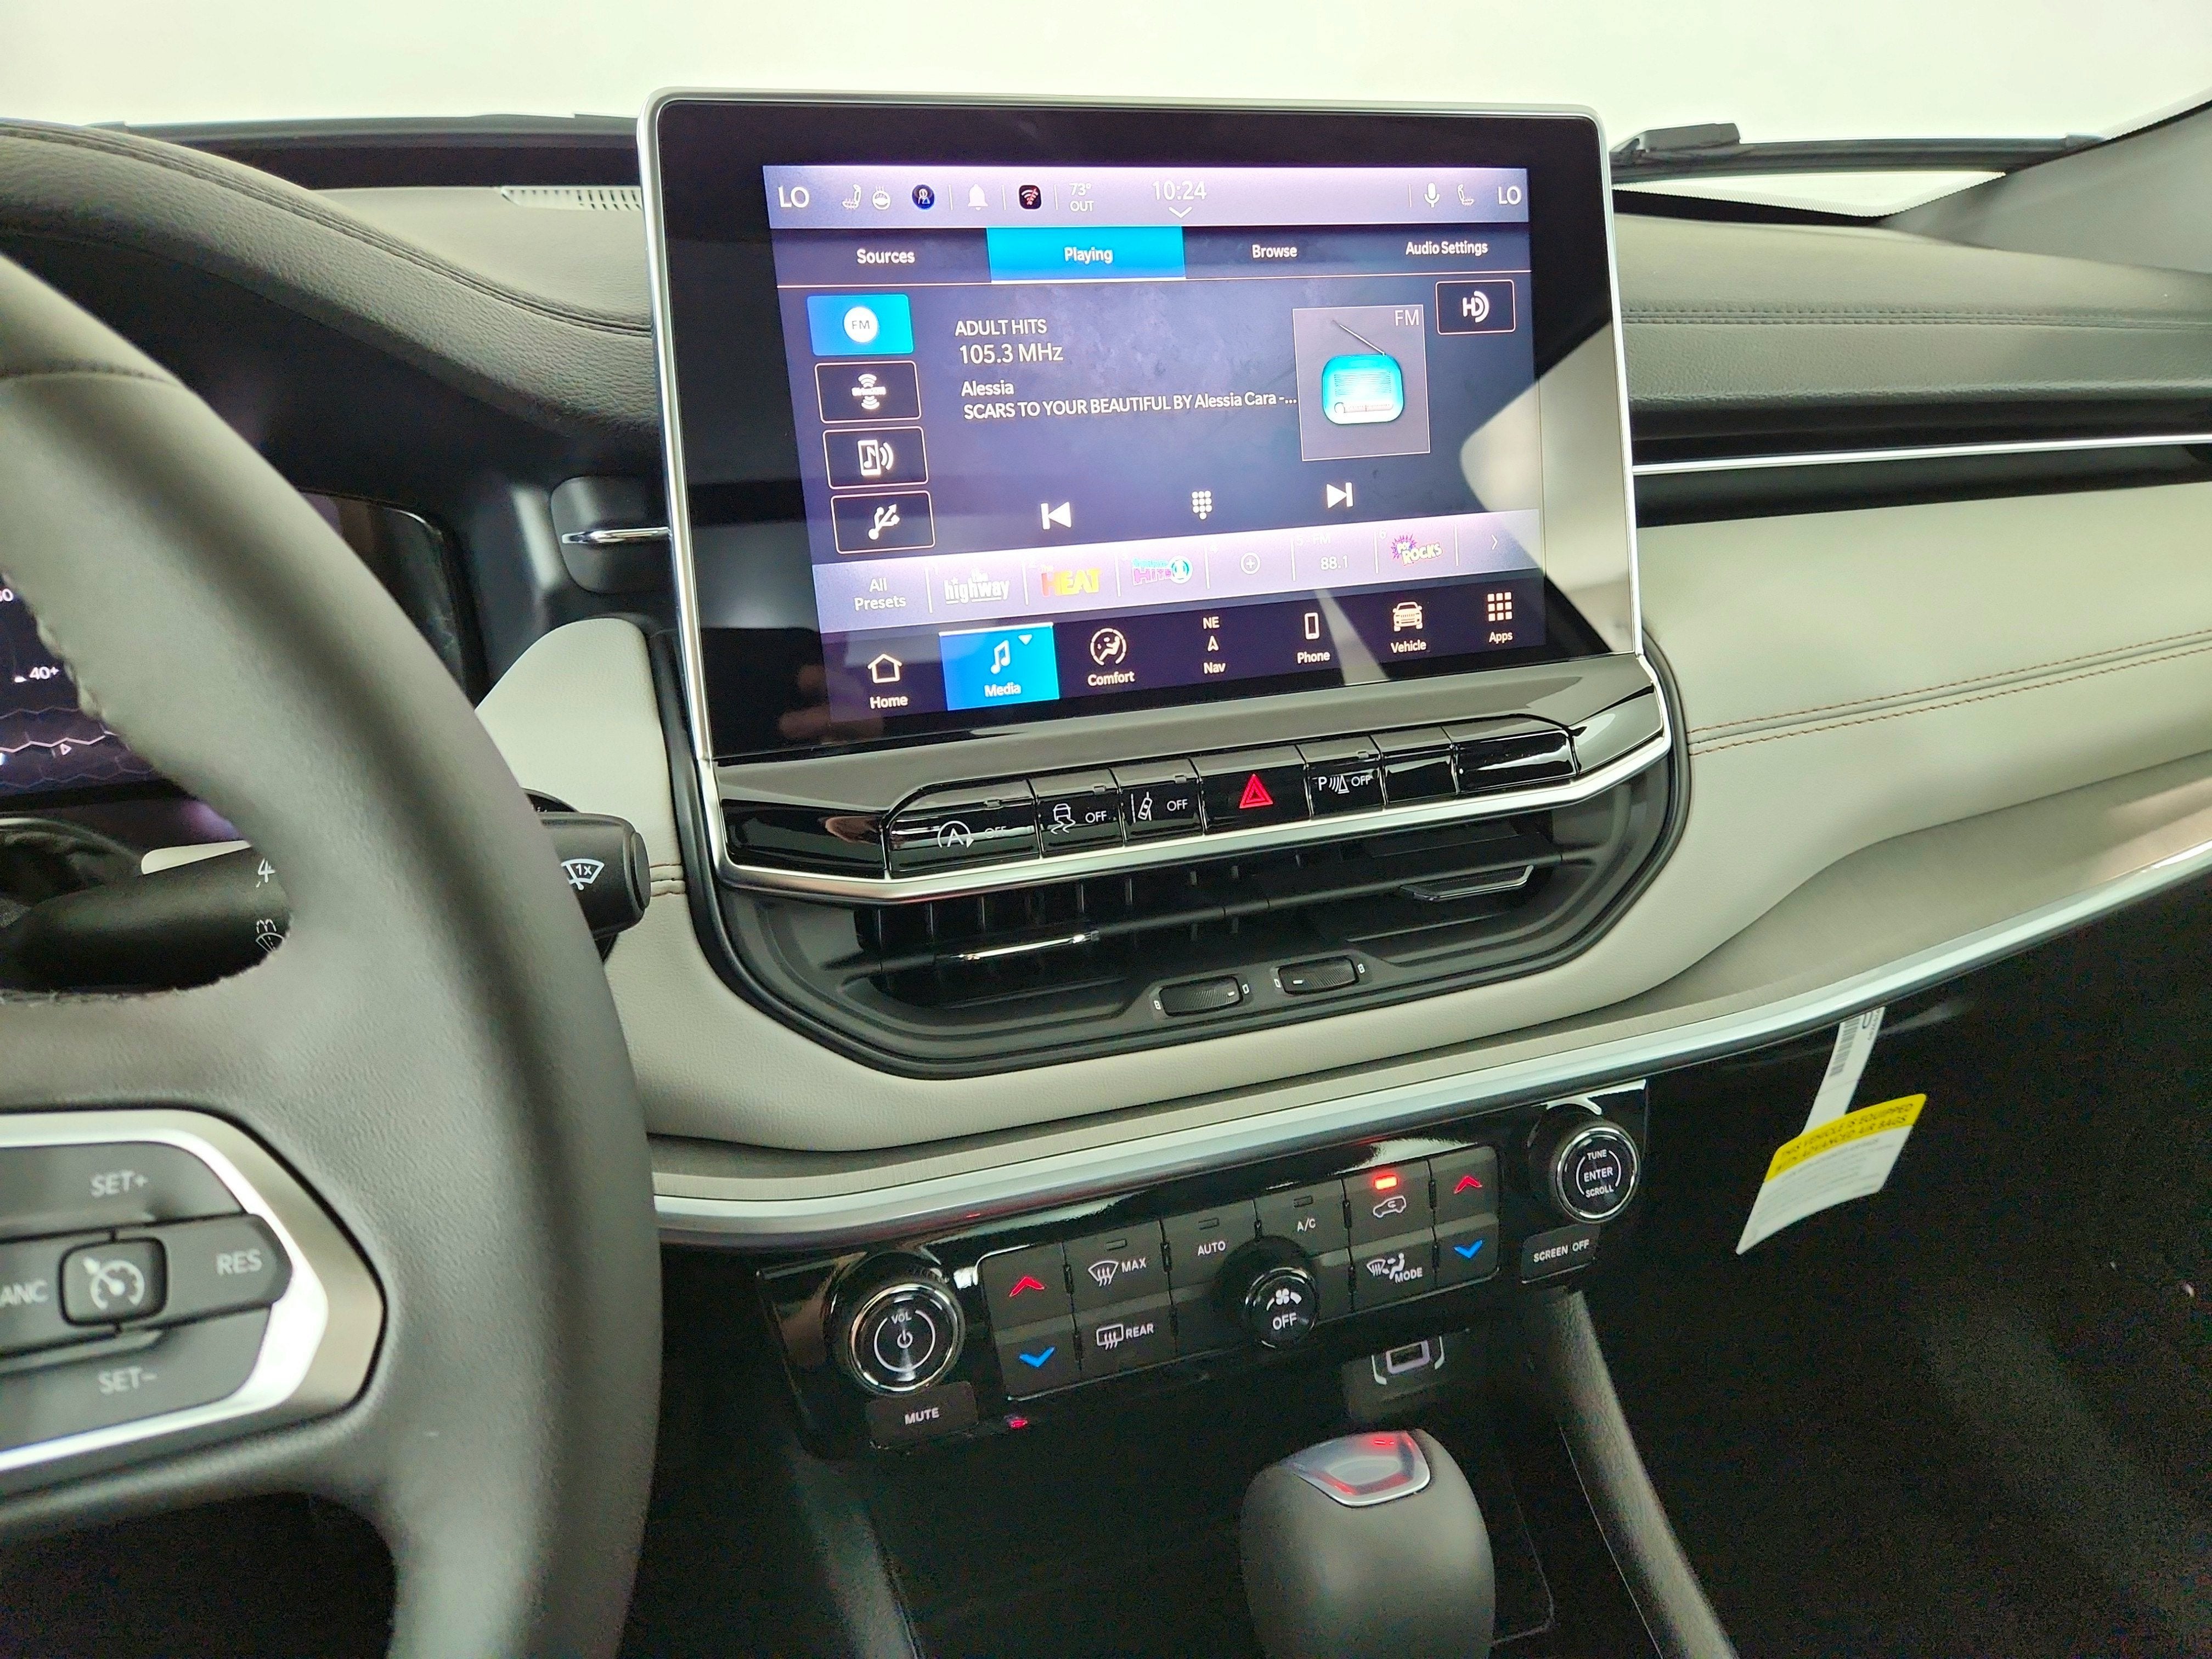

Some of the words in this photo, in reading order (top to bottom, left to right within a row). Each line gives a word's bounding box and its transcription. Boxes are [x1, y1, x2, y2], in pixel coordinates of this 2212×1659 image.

[778, 185, 809, 208] LO
[1152, 180, 1207, 201] 10:24
[1498, 186, 1522, 205] LO
[1069, 200, 1094, 212] OUT
[1064, 246, 1113, 264] Playing
[1252, 244, 1297, 259] Browse
[1406, 241, 1440, 256] Audio
[1441, 239, 1488, 256] Settings
[856, 249, 915, 264] Sources
[851, 319, 870, 330] FM
[1395, 309, 1419, 326] FM
[955, 319, 1008, 337] ADULT
[1012, 318, 1047, 335] HITS
[959, 343, 1014, 364] 105.3
[1018, 342, 1063, 362] MHz
[961, 380, 1014, 396] Alessia
[963, 402, 1015, 420] SCARS
[1017, 401, 1040, 417] TO
[1042, 399, 1088, 416] YOUR
[1090, 396, 1171, 414] BEAUTIFUL
[1173, 394, 1193, 410] BY
[1194, 392, 1243, 409] Alessia
[1244, 390, 1277, 407] Cara
[1402, 543, 1443, 565] ROCKS
[1321, 555, 1348, 570] 88.1
[869, 578, 887, 592] All
[944, 577, 1009, 603] highway
[1042, 567, 1101, 597] HEAT
[855, 594, 906, 611] Presets
[1203, 617, 1220, 629] NE
[1489, 630, 1513, 644] Apps
[1391, 639, 1426, 653] Vehicle
[1297, 650, 1330, 664] Phone
[29, 665, 59, 680] 40+
[1204, 662, 1226, 674] Nav
[1087, 671, 1135, 686] Comfort
[984, 682, 1022, 697] Media
[870, 695, 908, 709] Home
[1318, 776, 1327, 791] P
[1351, 775, 1373, 786] OFF
[1167, 799, 1188, 812] OFF
[1086, 811, 1108, 824] OFF
[985, 826, 1007, 839] OFF
[1586, 1149, 1607, 1161] TUNE
[1583, 1165, 1613, 1182] ENTER
[1585, 1183, 1614, 1199] SCROLL
[1297, 1217, 1316, 1233] A/C
[1197, 1240, 1226, 1256] AUTO
[1533, 1245, 1568, 1262] SCREEN
[1572, 1238, 1590, 1253] OFF
[216, 1249, 263, 1274] RES
[1121, 1257, 1146, 1272] MAX
[1394, 1267, 1423, 1283] MODE
[890, 1312, 912, 1324] VOL
[1272, 1313, 1297, 1331] OFF
[1125, 1323, 1153, 1339] REAR
[904, 1407, 939, 1425] MUTE
